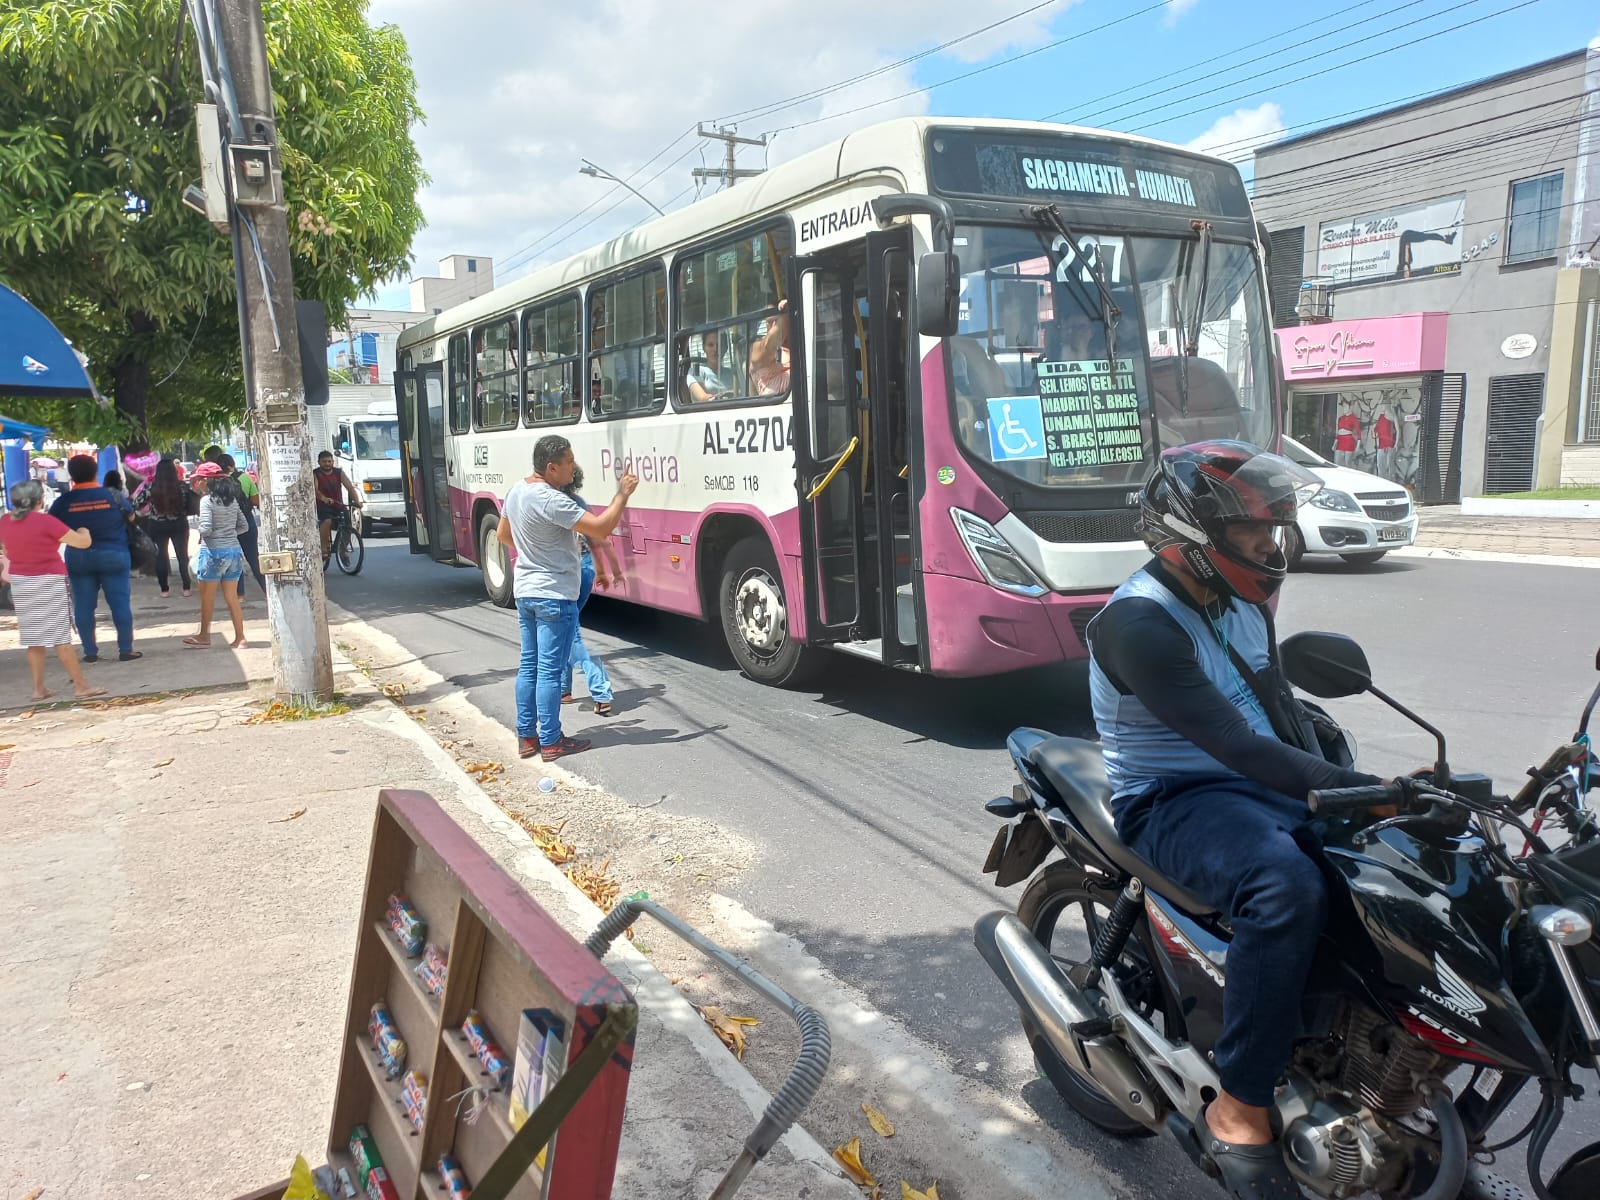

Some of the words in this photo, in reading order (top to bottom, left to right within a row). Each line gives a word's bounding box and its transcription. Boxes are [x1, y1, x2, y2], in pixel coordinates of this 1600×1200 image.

[1022, 157, 1129, 197] SACRAMENTA
[801, 201, 872, 243] ENTRADA
[1365, 217, 1399, 235] Mello
[1051, 234, 1124, 283] 227
[1046, 362, 1083, 373] IDA
[1040, 377, 1060, 394] SEN.
[1060, 376, 1088, 393] LEMOS
[1093, 395, 1105, 410] S.
[1106, 393, 1139, 409] BRAS
[1044, 414, 1093, 432] UNAMA
[1046, 435, 1060, 451] S.
[1061, 432, 1096, 449] BRAS
[601, 446, 679, 483] Pedreira
[742, 475, 760, 491] 118
[1170, 934, 1226, 988] FAN
[1419, 984, 1482, 1028] HONDA
